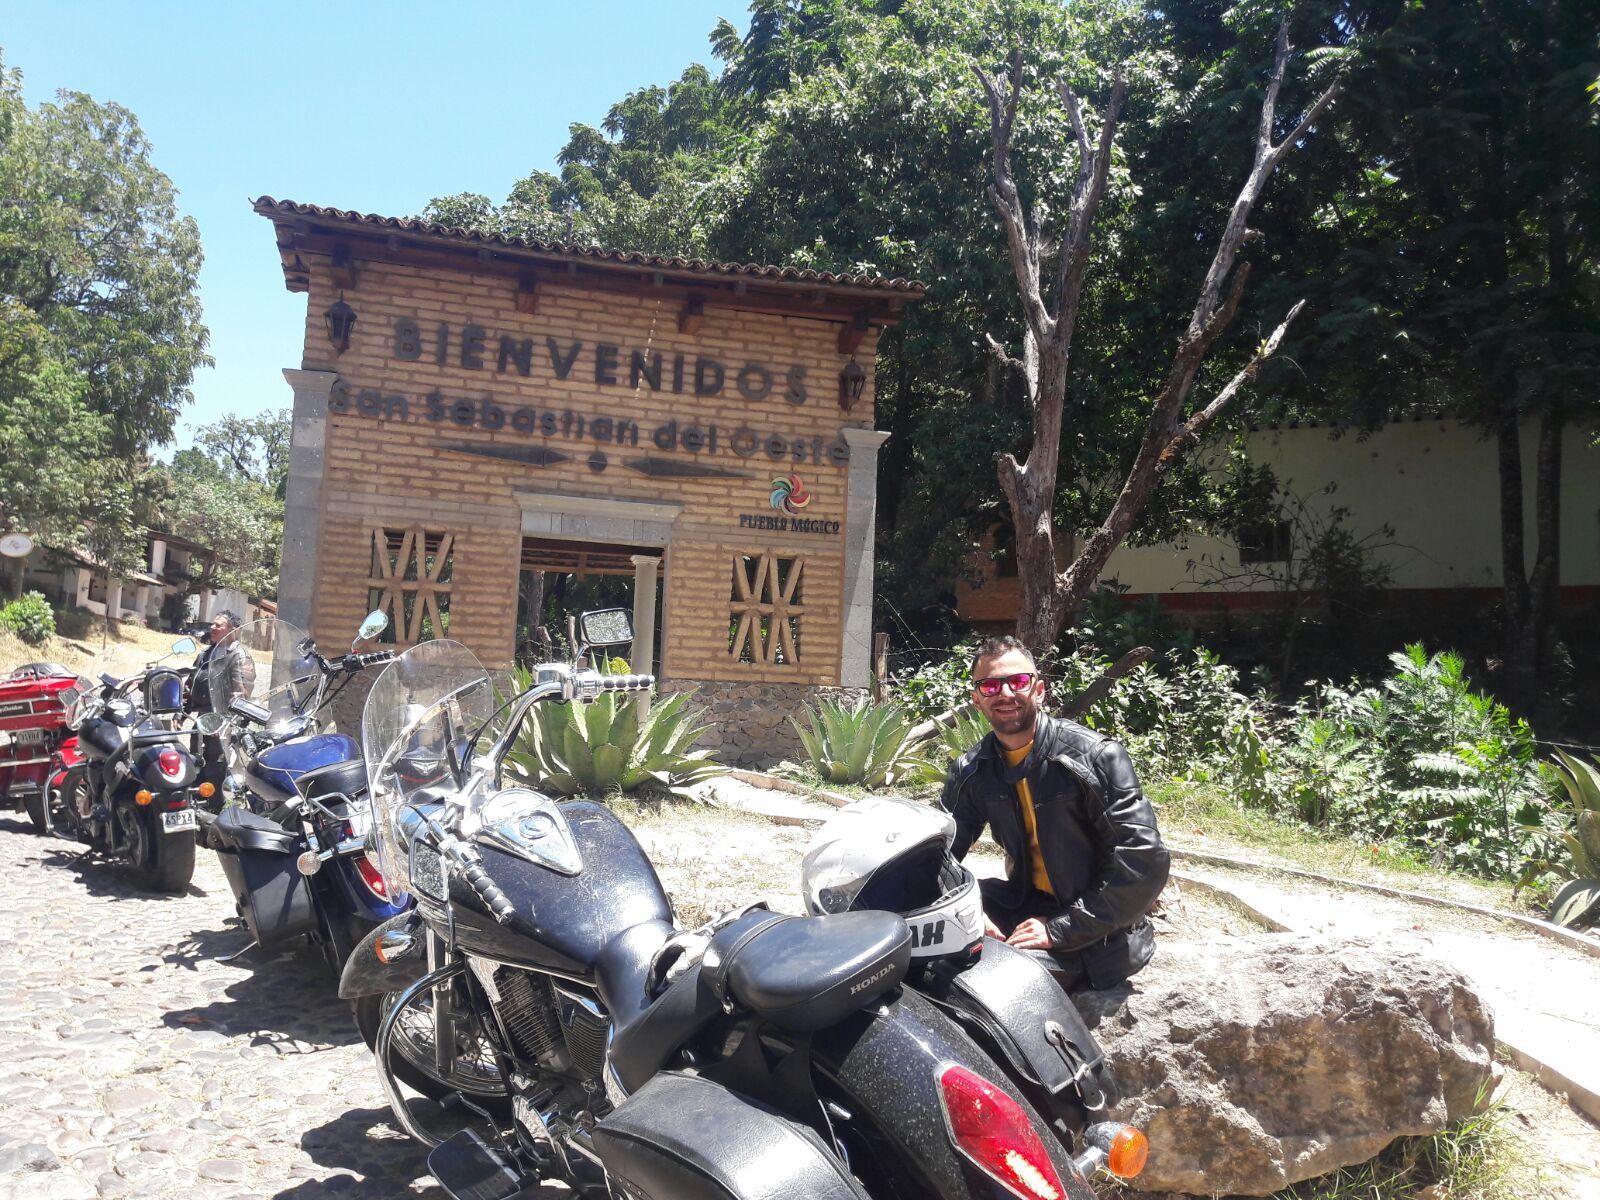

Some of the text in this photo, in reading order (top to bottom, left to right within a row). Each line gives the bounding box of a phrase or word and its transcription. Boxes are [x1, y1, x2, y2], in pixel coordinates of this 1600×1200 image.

[393, 317, 808, 405] BIENVENIDOS
[329, 380, 409, 421] San
[653, 418, 718, 455] del
[731, 427, 850, 467] Oeste
[850, 963, 896, 995] HONDA
